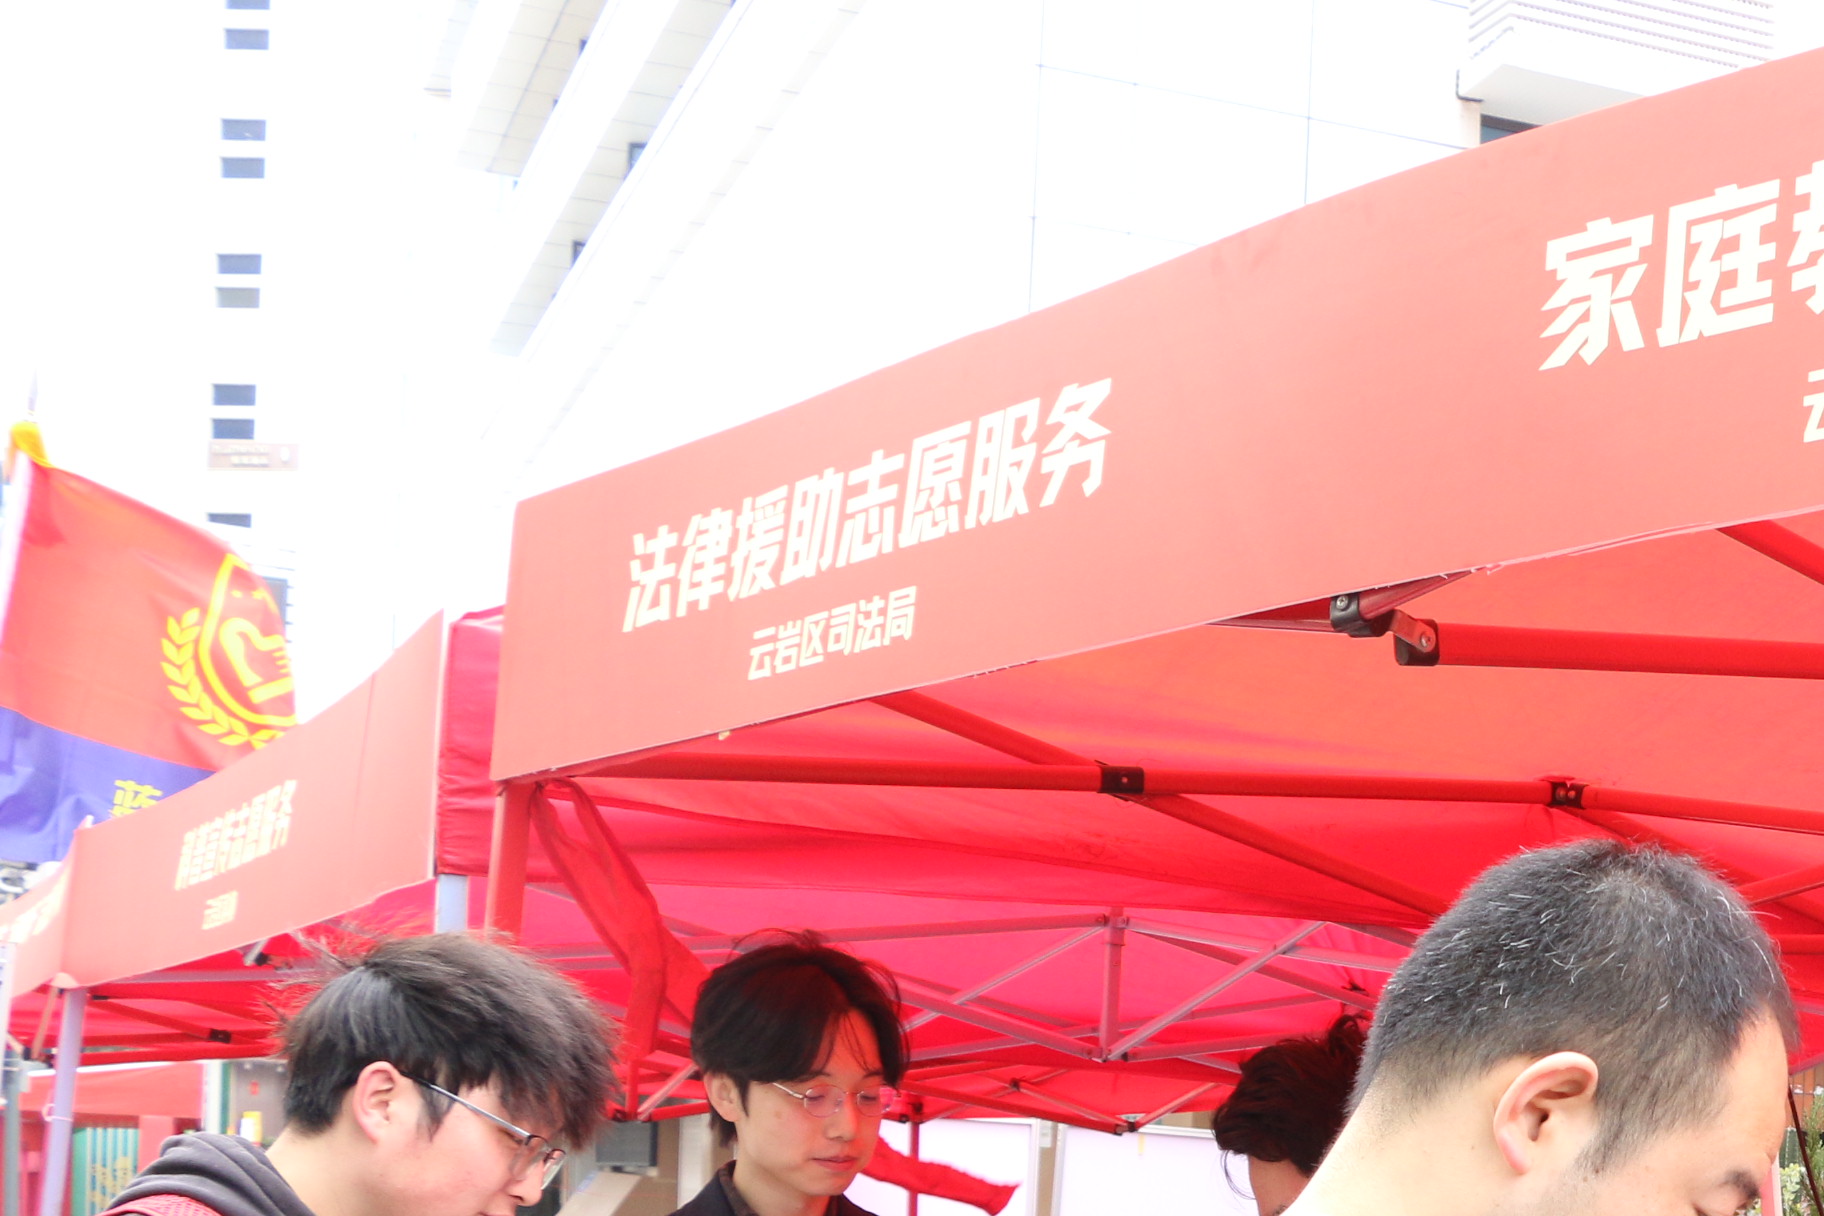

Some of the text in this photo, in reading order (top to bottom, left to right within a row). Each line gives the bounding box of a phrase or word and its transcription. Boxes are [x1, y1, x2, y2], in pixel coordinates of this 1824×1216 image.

[621, 377, 1113, 632] 法律援助志愿服务
[747, 585, 918, 680] 云岩区司法局
